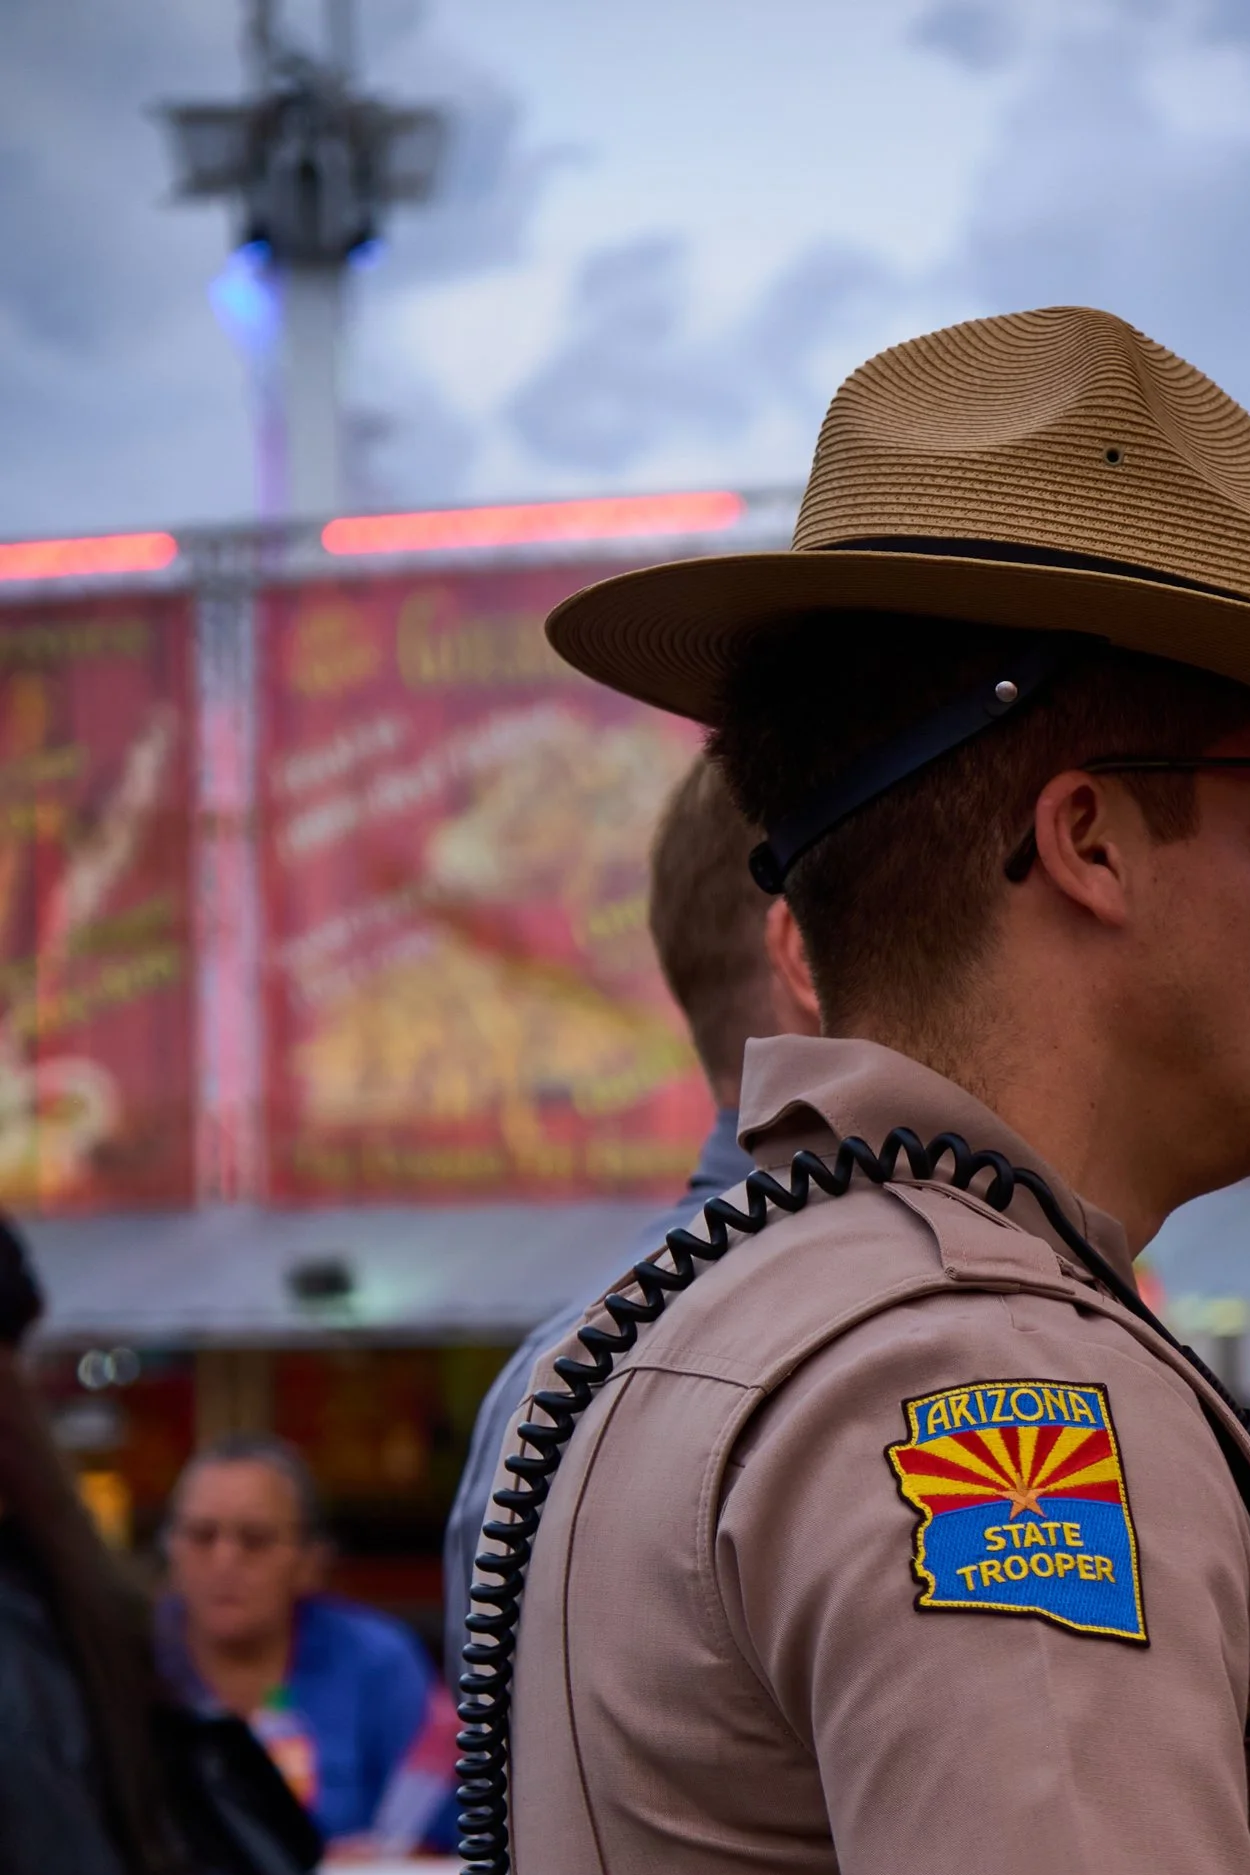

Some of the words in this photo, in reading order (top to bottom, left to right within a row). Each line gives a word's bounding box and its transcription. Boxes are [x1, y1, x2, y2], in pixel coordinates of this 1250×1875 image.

[926, 1387, 1097, 1435] ARIZONA
[983, 1521, 1084, 1552] STATE
[955, 1552, 1117, 1592] TROOPER
